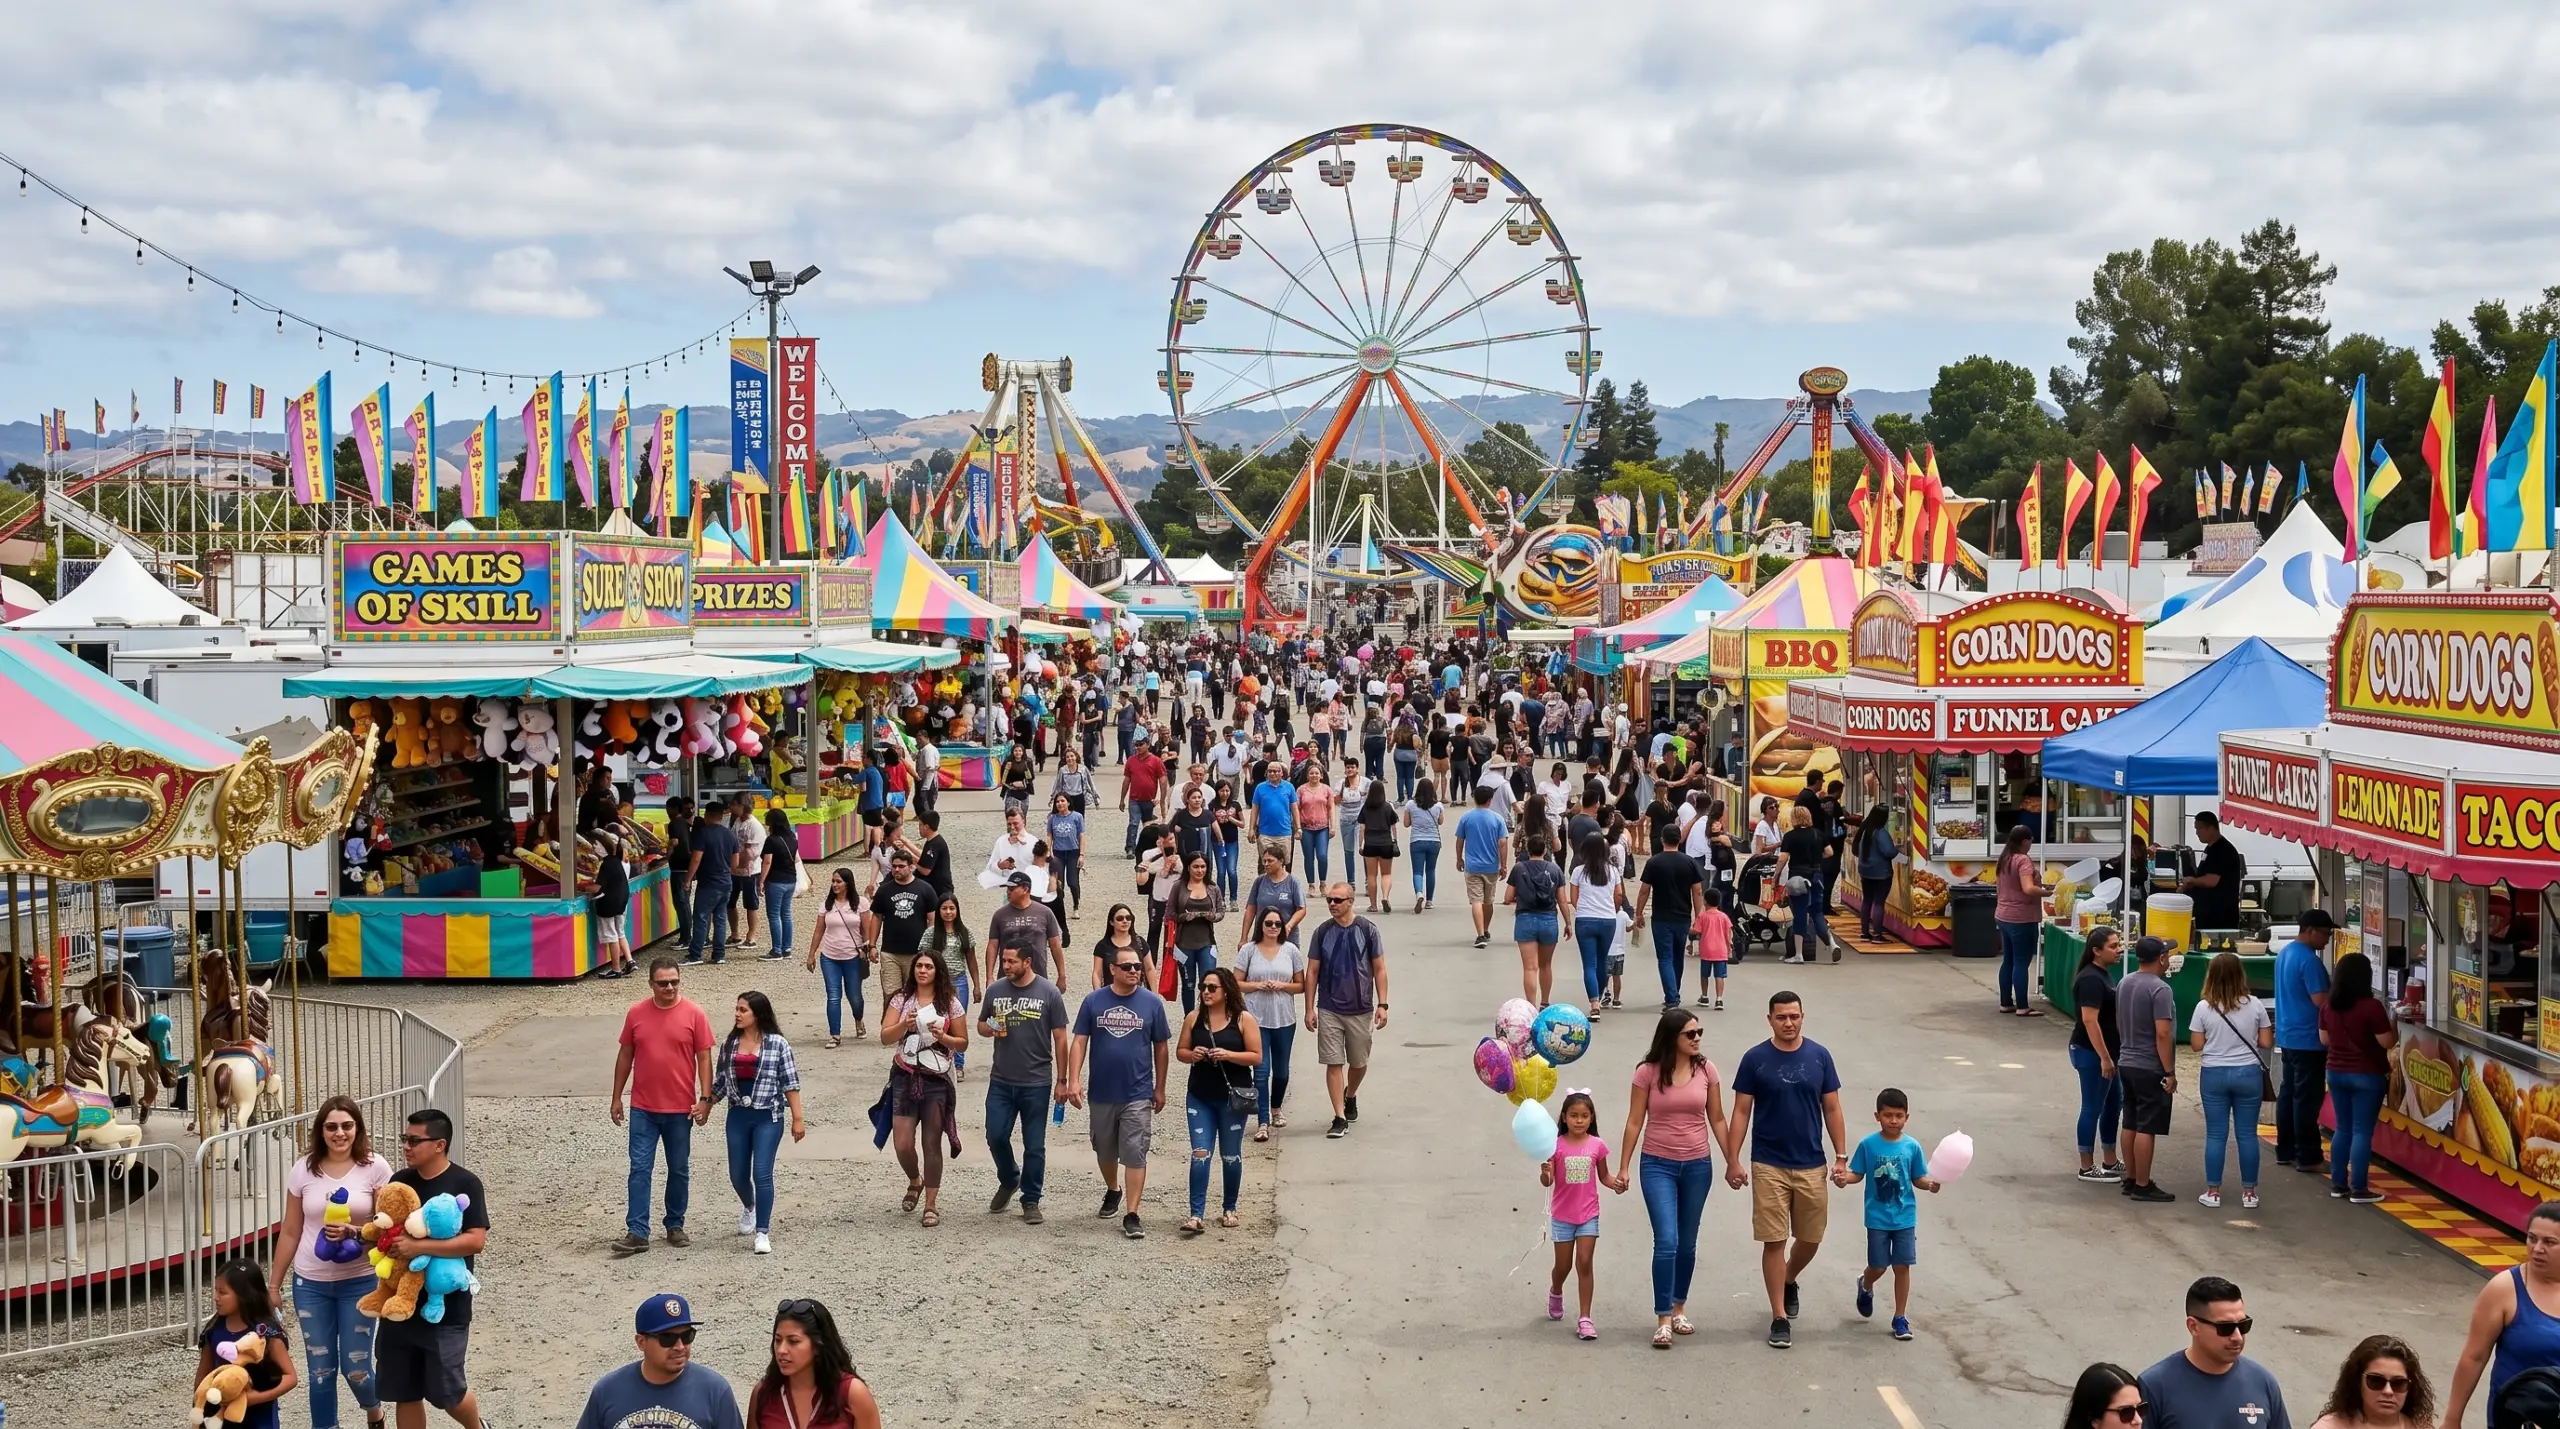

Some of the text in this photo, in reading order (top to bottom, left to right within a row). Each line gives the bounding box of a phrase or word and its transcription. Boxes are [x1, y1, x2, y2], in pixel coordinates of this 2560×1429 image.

[784, 345, 810, 480] WELCOME
[371, 553, 524, 586] GAMES
[583, 562, 684, 615] SURE SHOT
[357, 591, 540, 622] OF SKILL
[1764, 639, 1839, 673] BBQ
[1951, 623, 2030, 667] CORN
[2036, 623, 2114, 669] DOGS
[2369, 631, 2532, 710] CORN DOGS
[1847, 704, 1884, 732] CORN
[1887, 706, 1931, 734] DOGS
[1953, 707, 2128, 733] FUNNEL CAK
[2228, 752, 2318, 813] FUNNEL CAKES
[2337, 773, 2441, 839] LEMONADE
